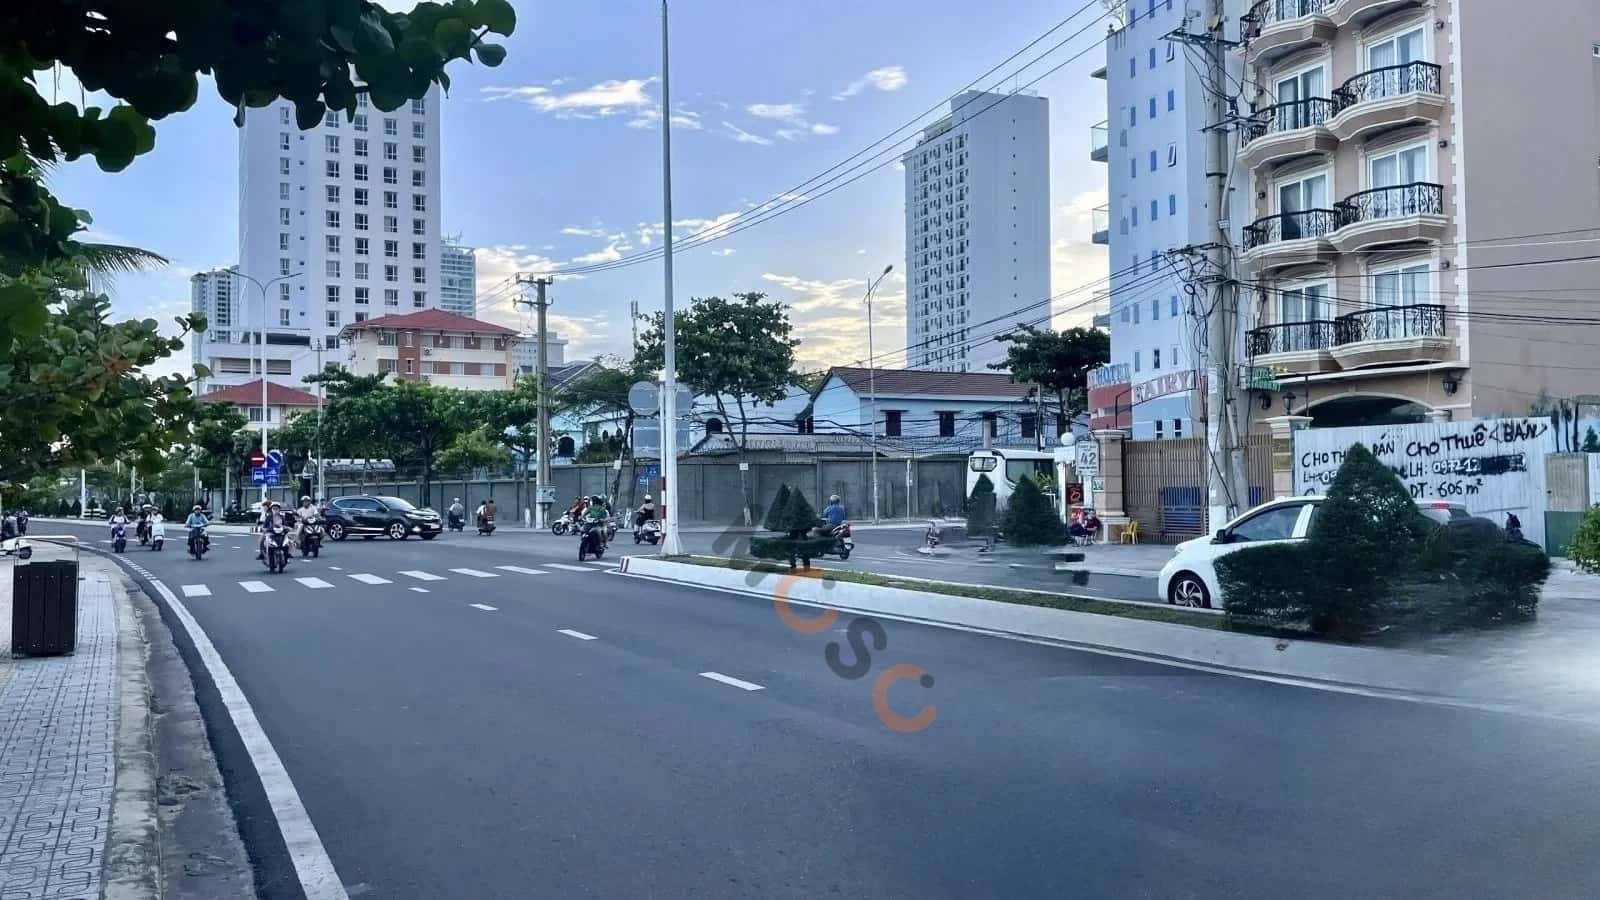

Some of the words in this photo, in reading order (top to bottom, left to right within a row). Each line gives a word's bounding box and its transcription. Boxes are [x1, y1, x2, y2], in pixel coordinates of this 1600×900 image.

[1134, 369, 1194, 402] FAIRY
[1406, 441, 1440, 457] Cho
[1441, 423, 1488, 450] Thuê
[1080, 451, 1098, 466] 42
[1409, 461, 1428, 478] LH:
[1410, 482, 1433, 499] DT:
